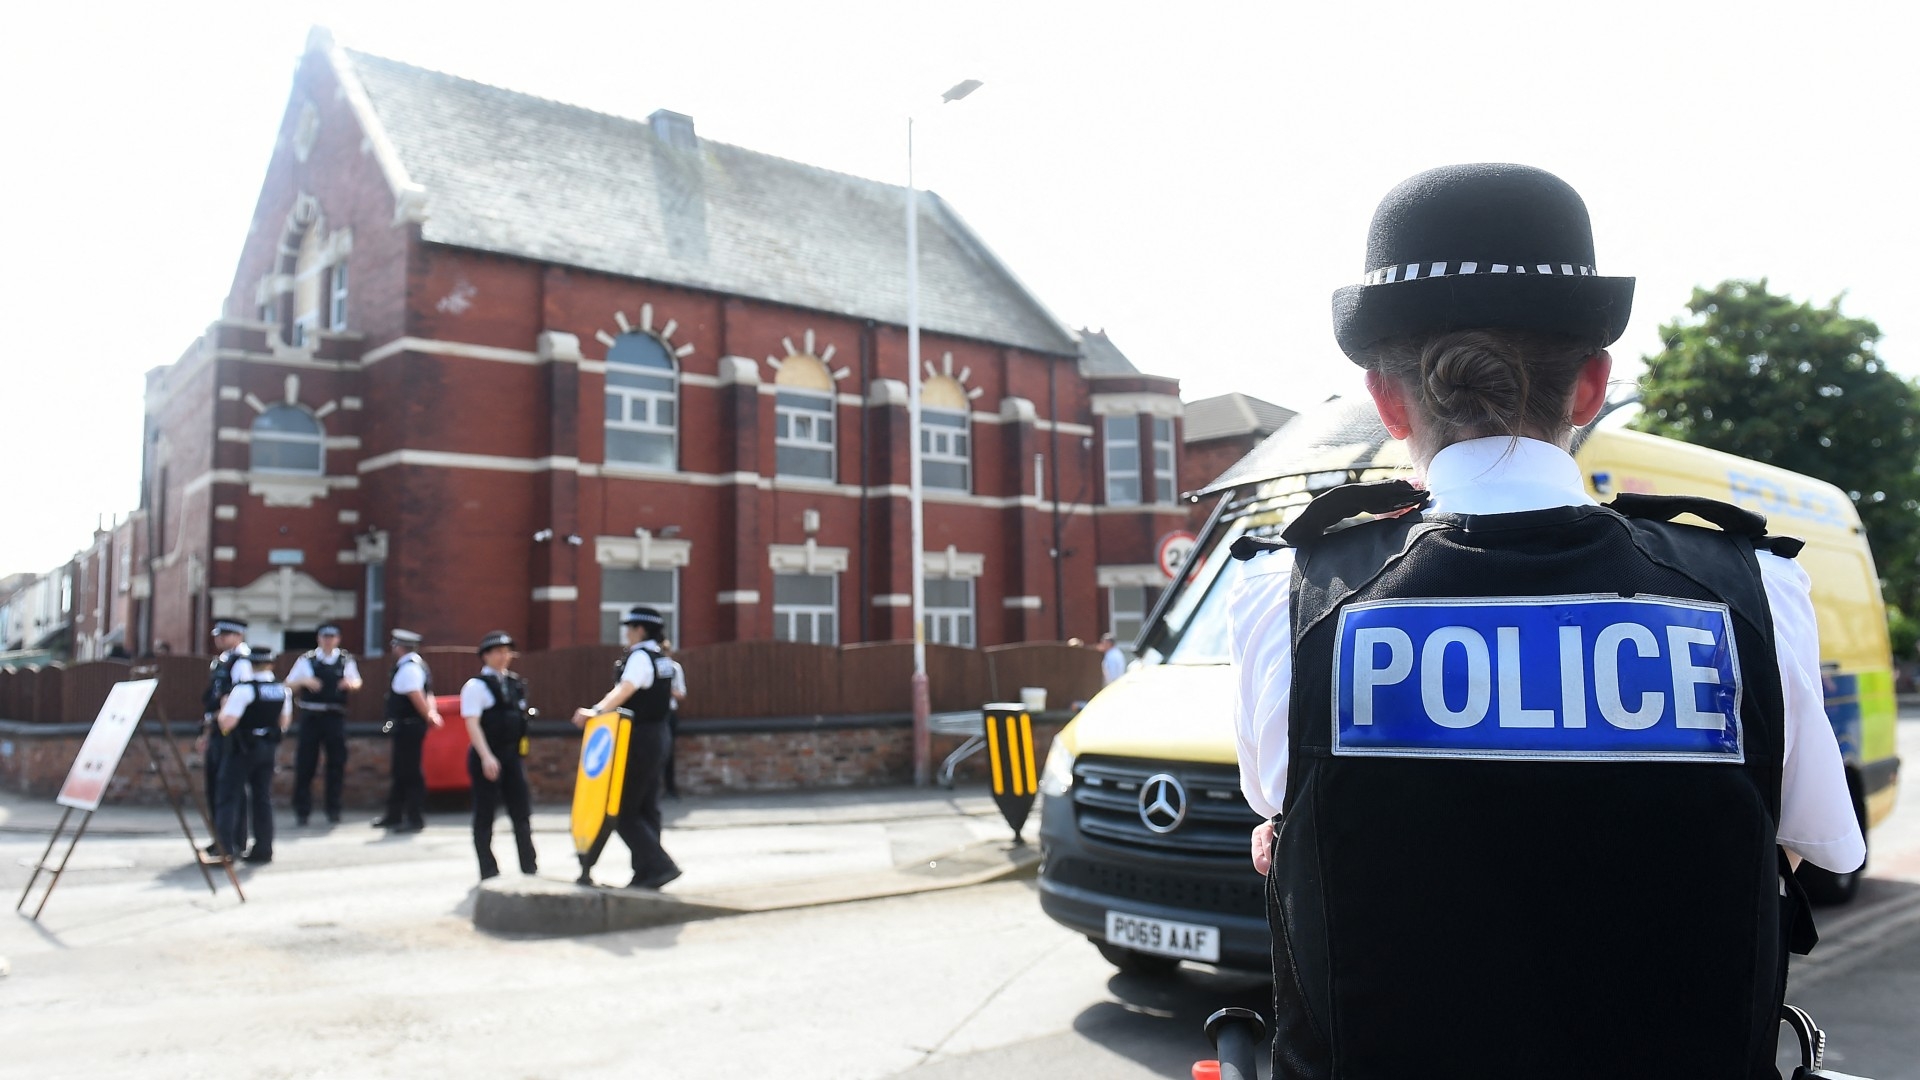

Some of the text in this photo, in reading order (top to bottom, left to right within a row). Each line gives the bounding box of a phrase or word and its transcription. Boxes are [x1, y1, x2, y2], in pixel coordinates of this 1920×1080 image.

[1352, 622, 1726, 731] POLICE
[1115, 917, 1206, 950] PO69 AAF
